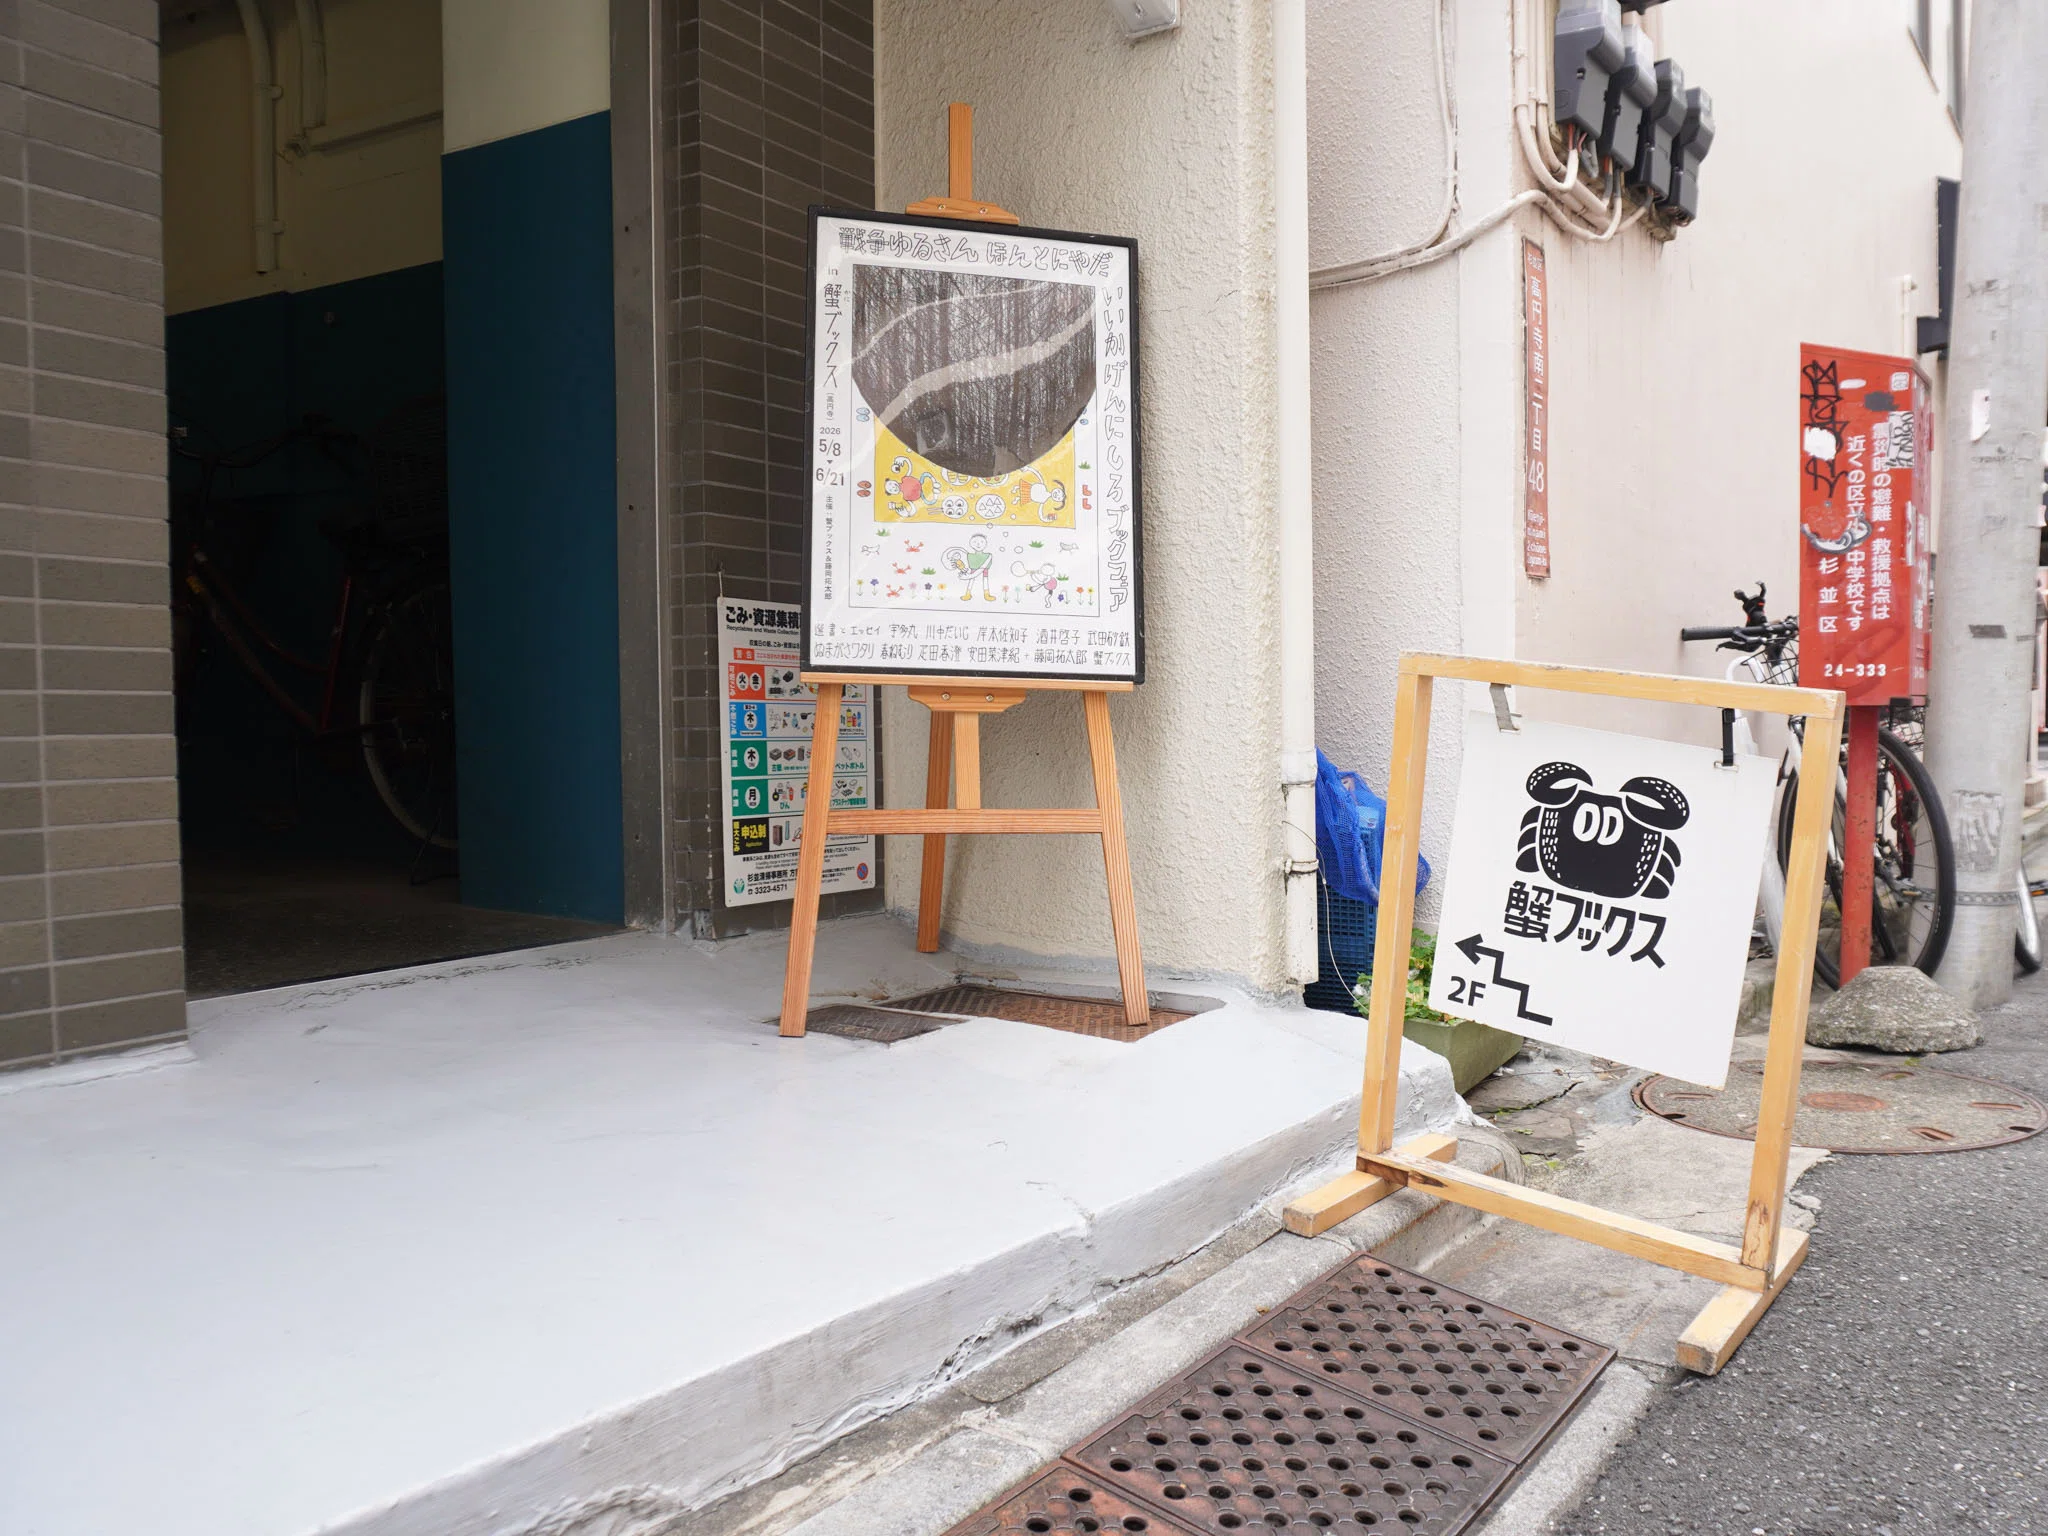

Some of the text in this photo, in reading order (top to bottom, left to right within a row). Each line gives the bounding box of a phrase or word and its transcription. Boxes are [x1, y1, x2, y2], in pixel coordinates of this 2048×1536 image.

[838, 226, 1114, 278] 戦争ゆるさん ほんとにやだ
[828, 267, 838, 276] in
[823, 283, 842, 389] 蟹ブックス
[819, 427, 842, 436] 2026
[818, 438, 842, 457] 5/8
[1101, 286, 1130, 612] いいかげんにしろブックフェア
[815, 467, 845, 486] 6/21
[1528, 459, 1545, 493] 48
[1818, 556, 1840, 634] 杉並区
[725, 605, 801, 630] ごみ・資源集積
[976, 625, 1029, 644] 岸本佐知子
[738, 672, 747, 685] 火
[1824, 663, 1887, 678] 24-333
[746, 711, 755, 724] 木
[747, 748, 756, 762] 木
[748, 788, 757, 802] 月
[755, 883, 788, 895] 3323-4571
[1503, 879, 1668, 969] 蟹ブックス
[1447, 975, 1487, 1007] 2F
